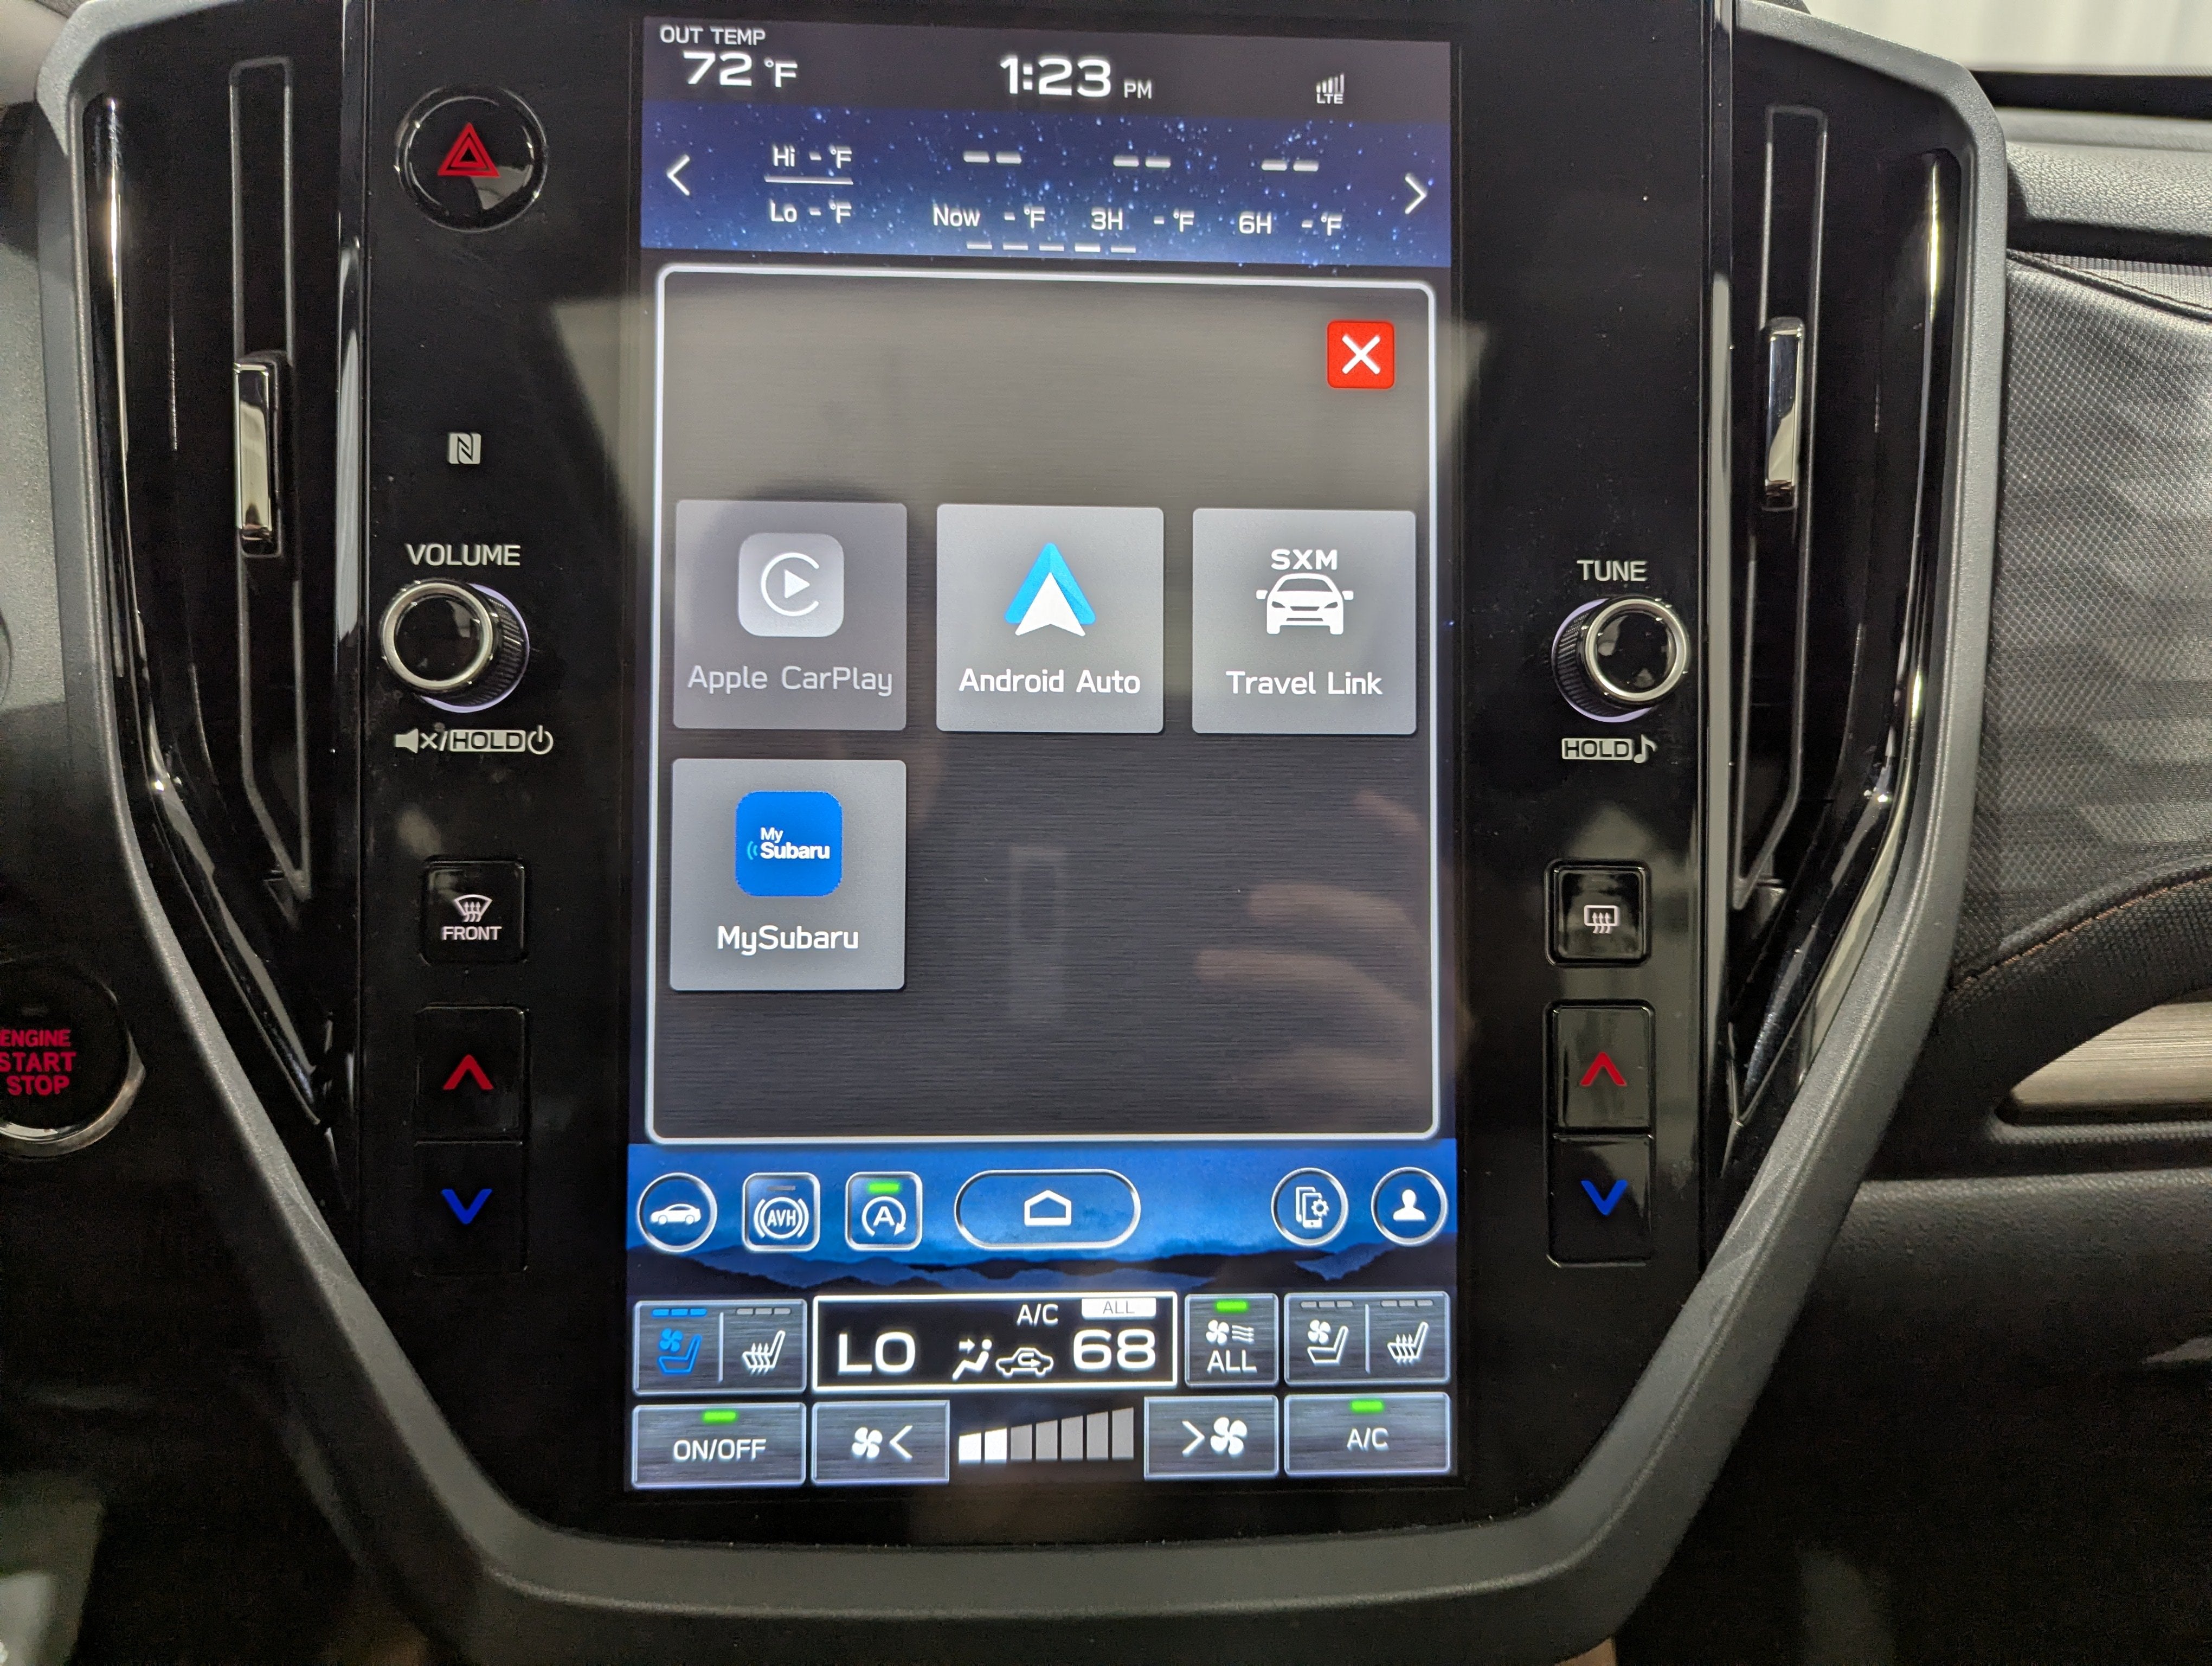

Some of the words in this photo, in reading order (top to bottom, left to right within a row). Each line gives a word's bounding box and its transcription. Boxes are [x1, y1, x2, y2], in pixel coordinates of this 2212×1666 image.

[660, 24, 703, 44] OUT
[711, 27, 766, 46] TEMP
[683, 50, 753, 87] 72
[1000, 53, 1112, 98] 1:23
[1123, 79, 1153, 99] PM
[1316, 93, 1344, 105] LTE
[772, 144, 796, 167] Hi
[769, 200, 798, 223] Lo
[933, 203, 980, 228] Now
[1091, 207, 1124, 231] 3H
[1238, 212, 1272, 235] 6H
[406, 543, 520, 566] VOLUME
[1270, 549, 1338, 571] SXM
[1577, 559, 1648, 582] TUNE
[687, 665, 768, 695] Apple
[781, 666, 893, 697] CarPlay
[959, 669, 1064, 694] Android
[1076, 670, 1141, 694] Auto
[1225, 670, 1314, 695] Travel
[1328, 672, 1383, 695] Link
[1561, 738, 1634, 760] HOLD
[760, 827, 784, 843] My
[760, 842, 831, 859] Subaru
[441, 926, 502, 940] FRONT
[717, 925, 859, 956] MySubaru
[0, 1029, 71, 1047] ENGINE
[0, 1052, 76, 1072] START
[6, 1075, 70, 1095] STOP
[766, 1209, 797, 1227] AVH
[1017, 1303, 1059, 1327] A/C
[1102, 1301, 1135, 1315] ALL
[838, 1332, 917, 1375] LO
[1073, 1328, 1156, 1372] 68
[1207, 1350, 1257, 1374] ALL
[673, 1438, 767, 1462] ON/OFF
[1347, 1427, 1389, 1450] A/C
